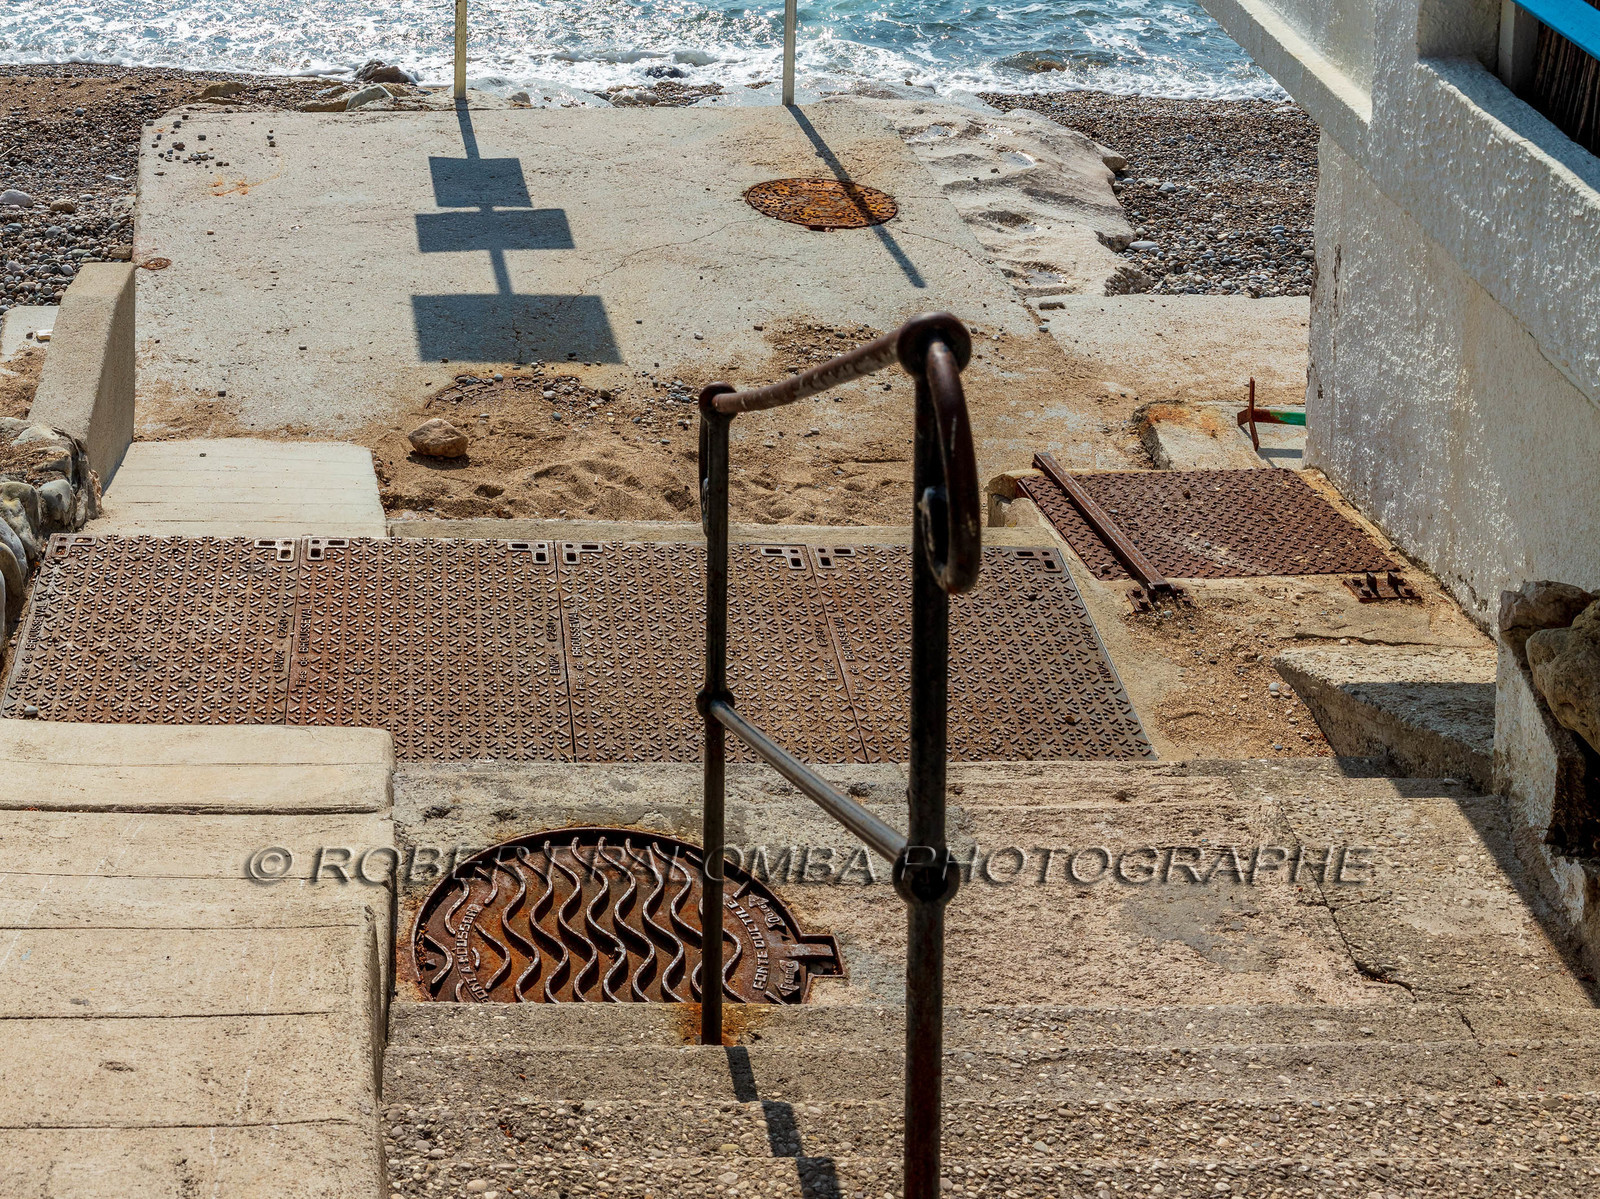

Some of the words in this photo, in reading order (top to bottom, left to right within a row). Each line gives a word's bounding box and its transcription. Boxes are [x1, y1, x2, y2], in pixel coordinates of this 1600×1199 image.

[298, 606, 312, 654] BROUSSEVAL
[569, 610, 583, 657] BROUSSEVAL
[834, 613, 855, 661] BROUSSEVAL
[456, 904, 483, 963] MOUSSON
[727, 899, 766, 948] DUCTILE
[752, 950, 769, 989] FONTE
